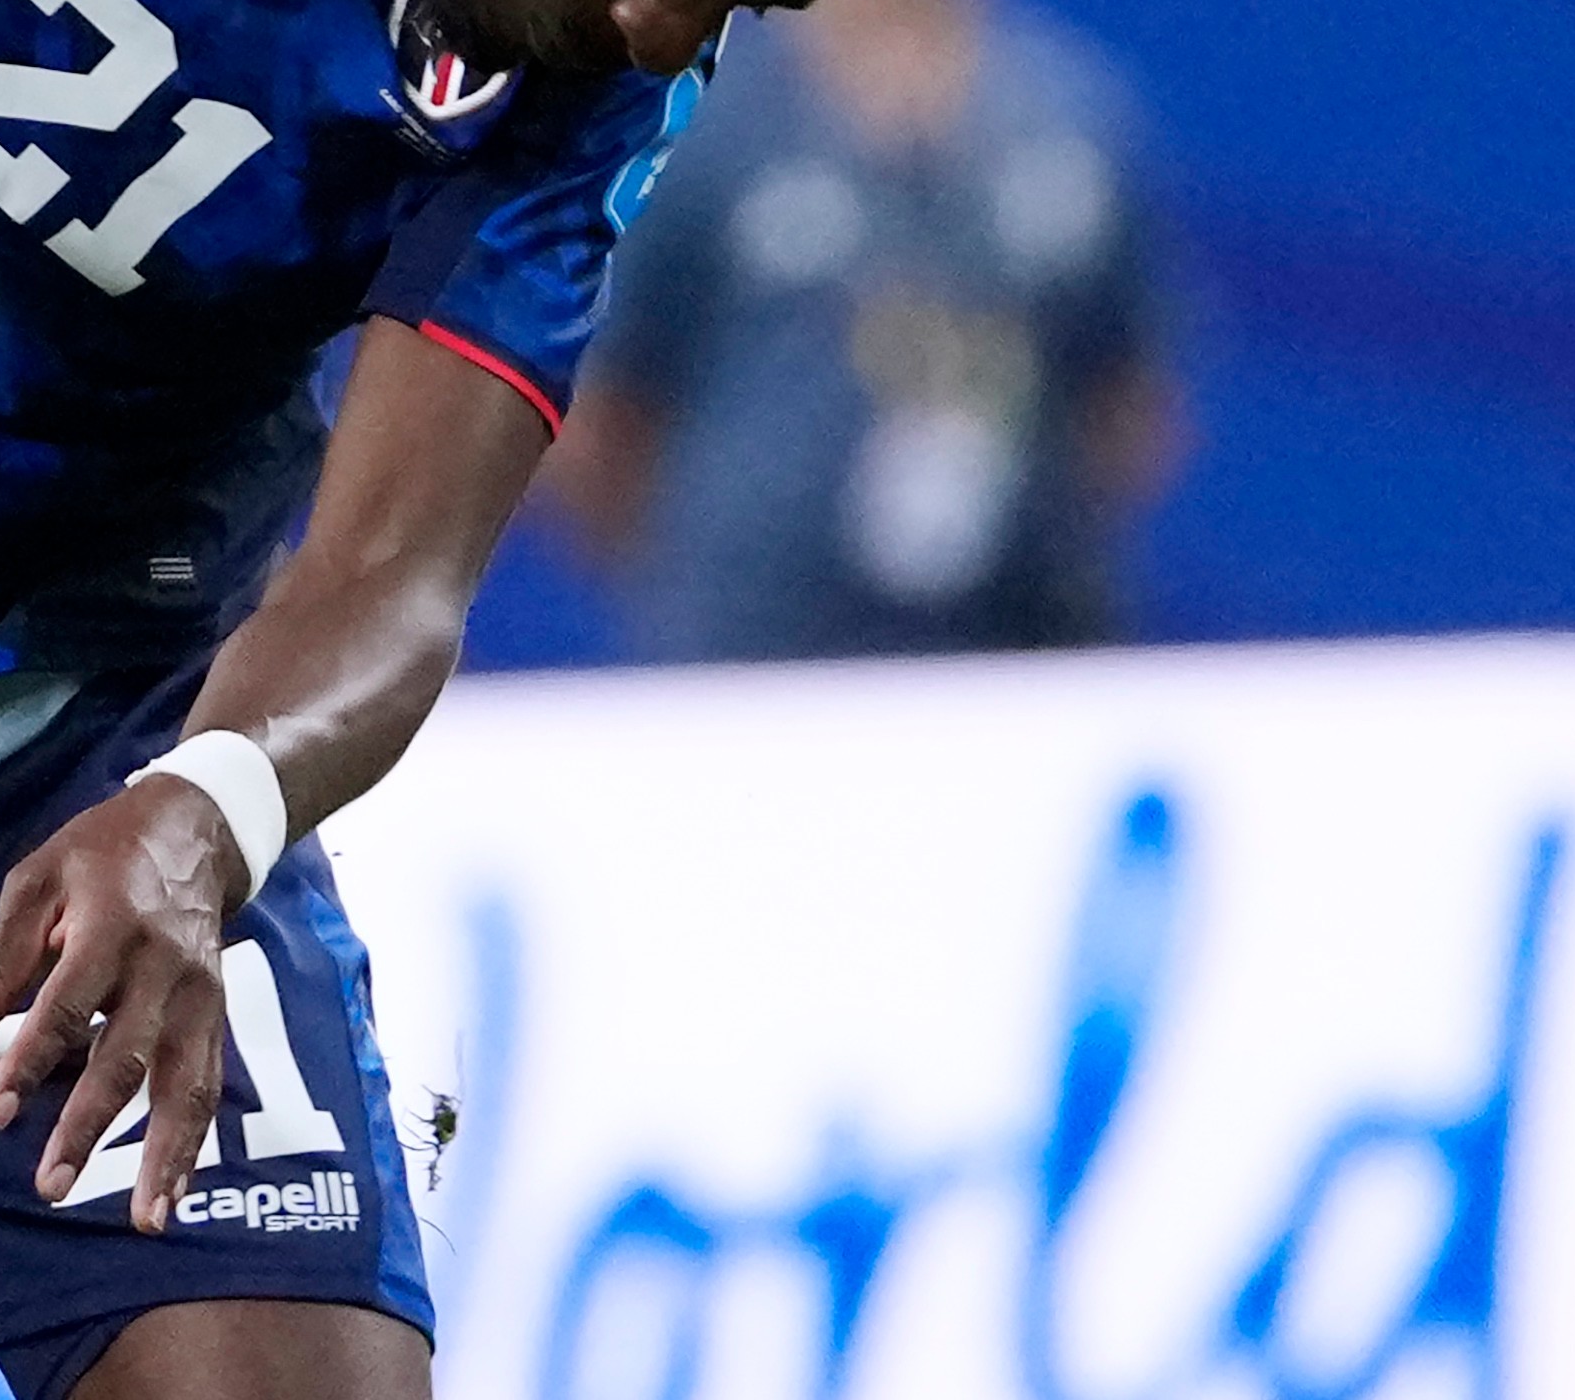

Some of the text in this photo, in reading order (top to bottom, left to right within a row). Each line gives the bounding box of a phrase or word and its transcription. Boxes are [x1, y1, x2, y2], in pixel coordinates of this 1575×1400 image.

[445, 770, 1565, 1400] orld
[176, 1171, 360, 1228] capelli
[265, 1215, 361, 1232] SPORT
